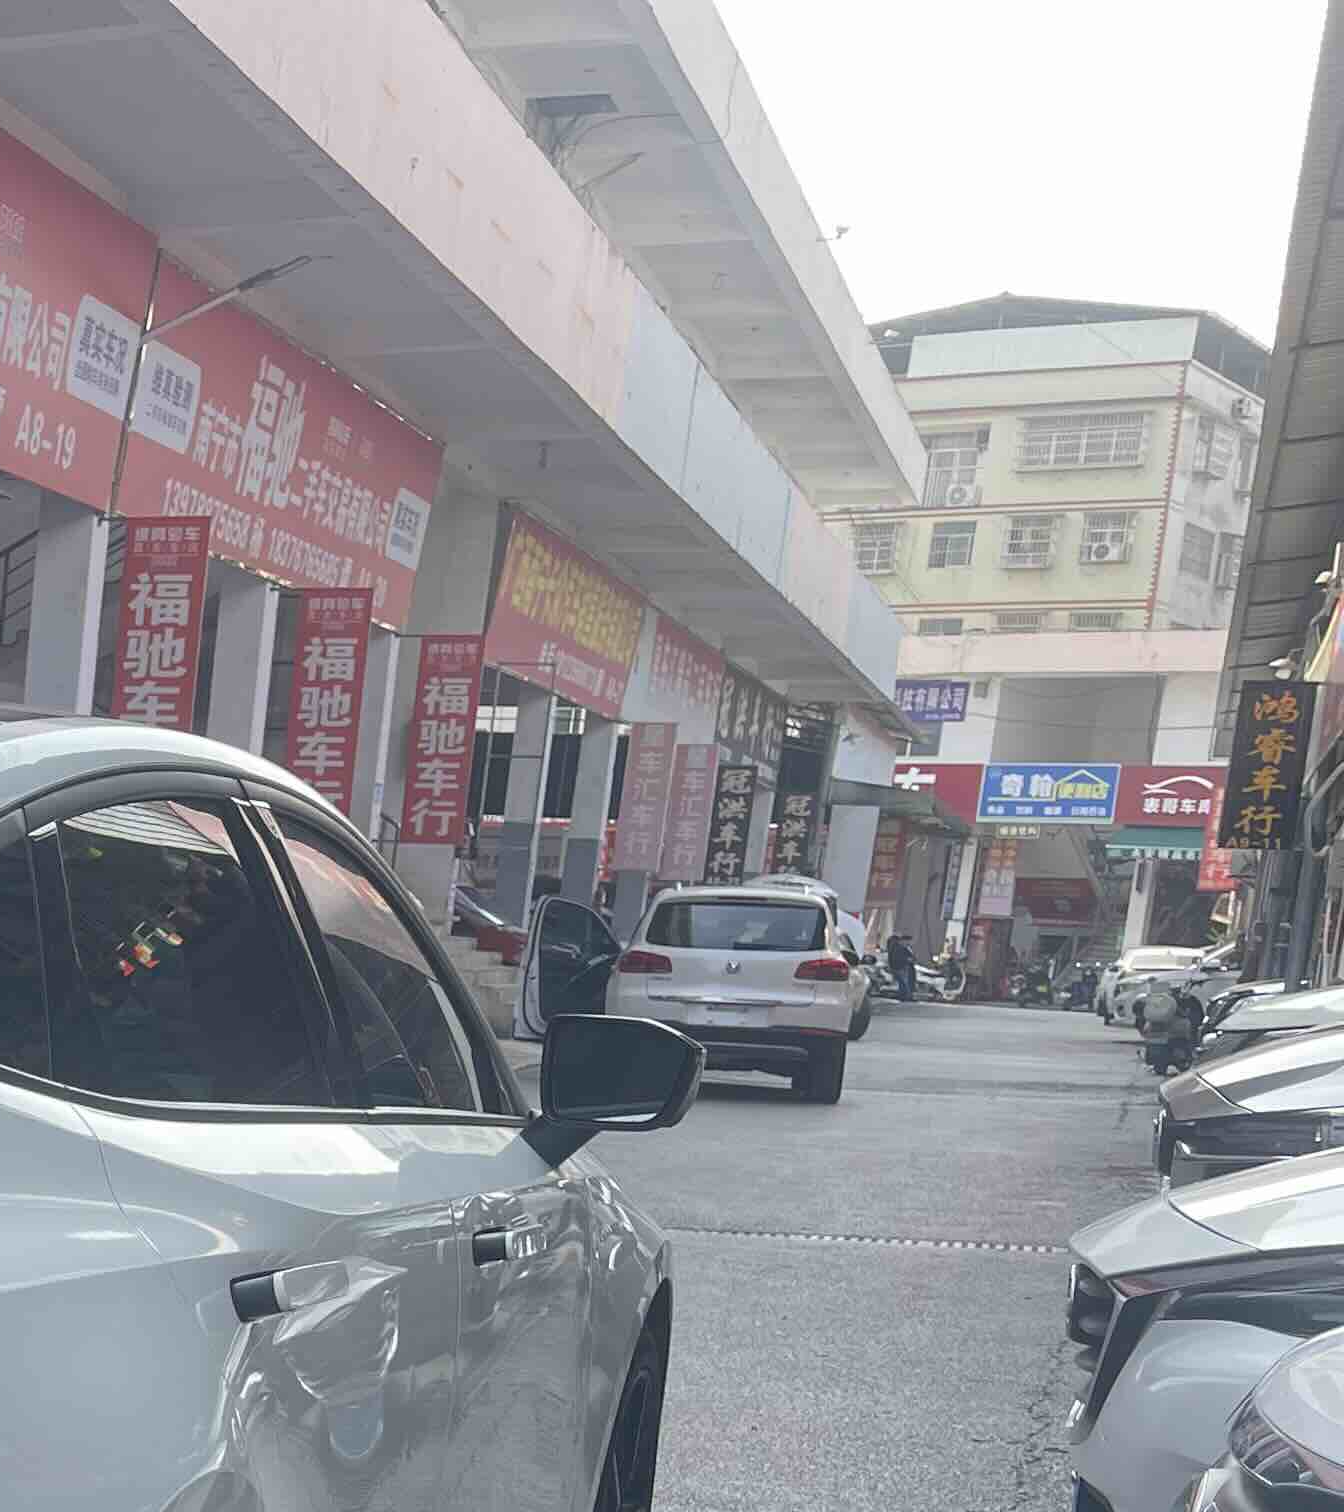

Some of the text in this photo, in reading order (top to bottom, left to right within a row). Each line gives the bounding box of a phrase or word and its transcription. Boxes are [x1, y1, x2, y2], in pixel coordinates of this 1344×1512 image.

[14, 404, 77, 470] A8-19
[409, 676, 473, 837] 福驰车行
